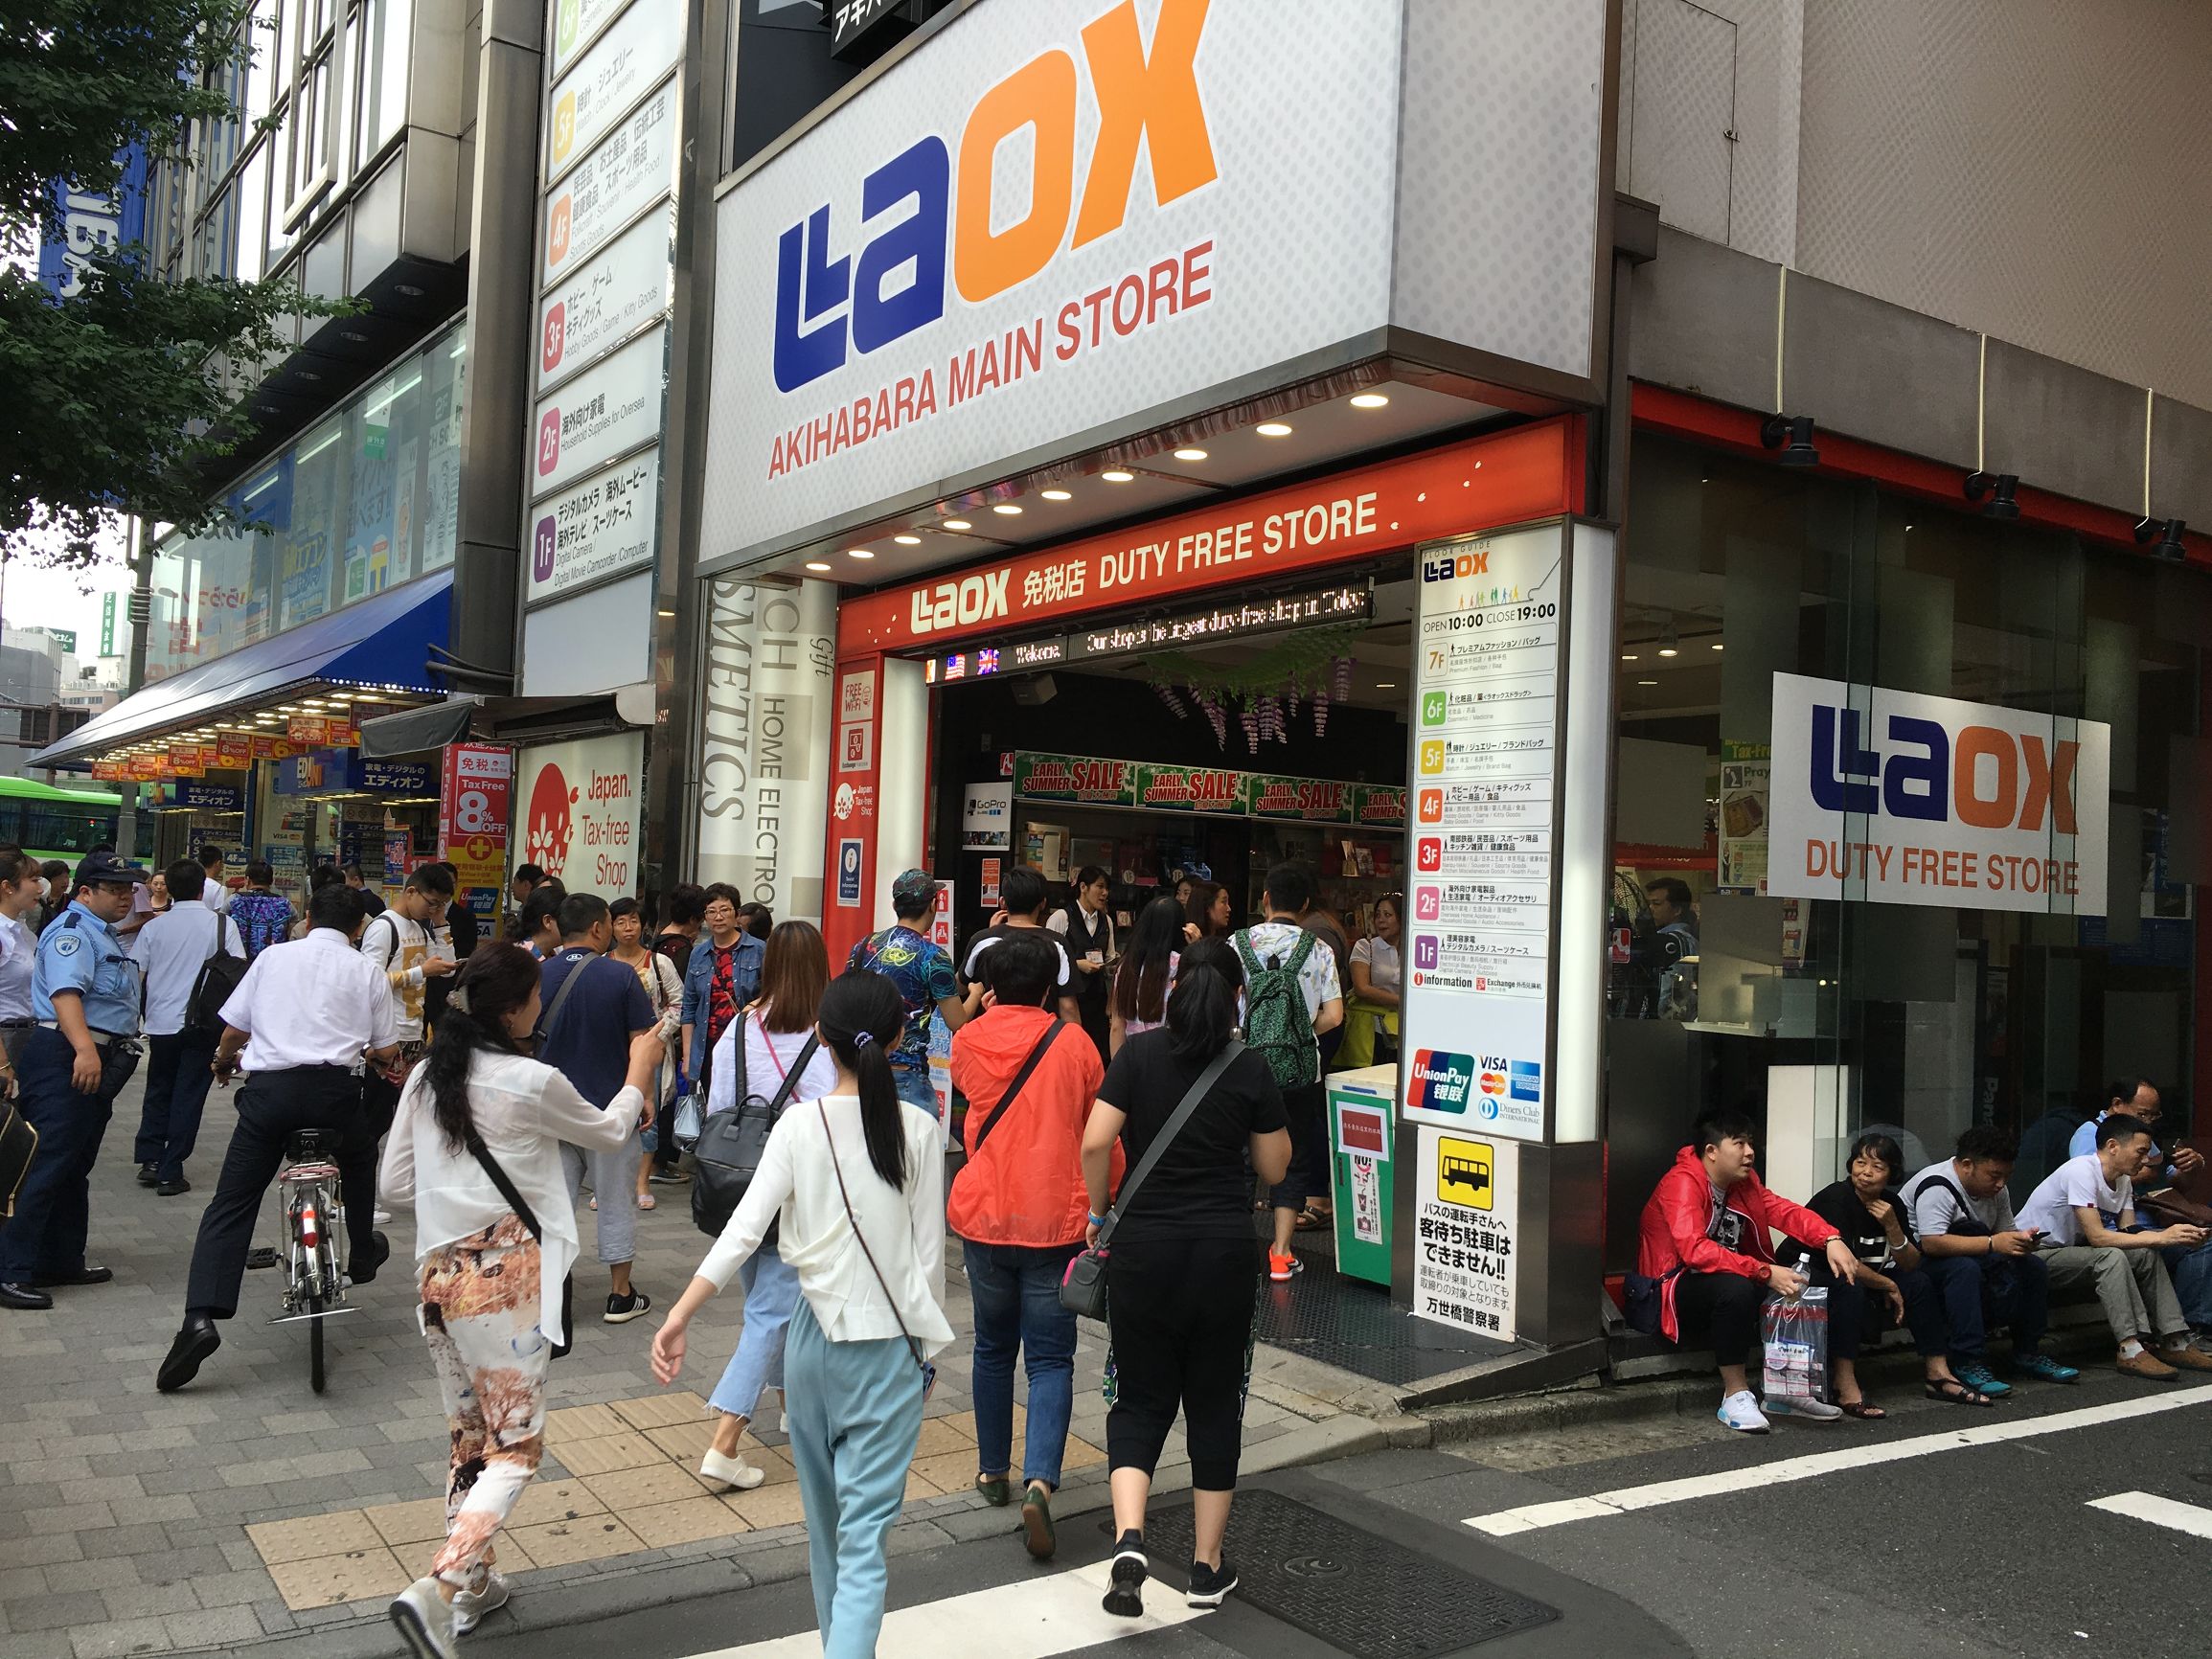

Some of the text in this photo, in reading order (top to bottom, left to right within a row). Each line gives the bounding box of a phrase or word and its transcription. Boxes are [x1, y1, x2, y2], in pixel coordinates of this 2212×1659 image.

[599, 48, 633, 92] ジュエリー
[558, 112, 571, 148] 5F
[605, 140, 648, 193] スポーツ用品
[552, 214, 567, 248] 4F
[567, 265, 612, 314] ホビー ゲーム
[603, 314, 619, 332] Game
[637, 285, 658, 309] Goods
[547, 321, 561, 357] 3F
[768, 240, 1213, 480] AKIHABARA MAIN STORE
[561, 393, 605, 436] 海外向け家電
[560, 428, 587, 452] Household
[588, 416, 611, 437] Supplies
[620, 397, 645, 420] Oversea
[543, 426, 557, 462] 2F
[558, 466, 648, 525] デジタルカメラ 海外ムービー
[557, 499, 632, 550] 海外テレビ スーツケース
[539, 534, 551, 567] 1F
[1022, 560, 1086, 609] 免税店
[1100, 540, 1171, 590] DUTY
[1176, 521, 1253, 572] FREE
[1263, 492, 1377, 555] STORE
[1461, 541, 1491, 553] GUIDE
[556, 550, 572, 567] Digital
[555, 553, 617, 587] Digital Movie Camcorder
[1424, 602, 1556, 633] OPEN 10:00 CLOSE 19:00
[1457, 636, 1540, 654] プレミアムファッション バッグ
[810, 637, 834, 677] Gift
[1429, 651, 1444, 670] 7F
[845, 682, 862, 697] FREE
[1455, 693, 1472, 703] 化粧品
[845, 698, 861, 712] Wi-Fi
[1426, 700, 1442, 718] 6F
[1470, 742, 1496, 752] ジュエリー
[1503, 739, 1544, 749] ブランドバッグ
[462, 757, 489, 771] 免税
[1425, 748, 1441, 767] 5F
[1034, 763, 1064, 777] EARLY
[1072, 762, 1124, 790] SALE
[364, 775, 425, 788] エディオン
[588, 769, 631, 807] Japan.
[857, 785, 873, 795] Japan
[1023, 778, 1070, 791] SUMMER
[1153, 774, 1183, 787] EARLY
[1189, 773, 1237, 800] SALE
[1496, 783, 1531, 791] キティグッズ
[1145, 787, 1187, 801] SUMMER
[1266, 784, 1292, 797] EARLY
[1298, 783, 1343, 809] SALE
[1368, 793, 1394, 806] EARLY
[1451, 792, 1499, 802] ベビー用品 食品
[188, 796, 234, 806] エディオン
[753, 697, 786, 912] HOME ELECTRO
[977, 800, 1006, 808] GoPro
[1257, 797, 1296, 810] SUMMER
[1424, 796, 1439, 815] 4F
[860, 807, 873, 817] Shop
[1360, 807, 1397, 819] SUMMER
[482, 824, 505, 832] OFF
[582, 814, 629, 846] Tax-free
[1500, 834, 1539, 843] スポーツ用品
[1423, 845, 1437, 864] 3F
[596, 853, 627, 894] Shop
[1806, 839, 2080, 896] DUTY FREE STORE
[1448, 885, 1494, 894] 海外向け家電製品
[1421, 893, 1436, 913] 2F
[1421, 943, 1434, 962] 1F
[1447, 943, 1529, 955] デジタルカメラ スーツケース
[1424, 973, 1516, 989] information Exchange
[1479, 1056, 1508, 1072] VISA
[1415, 1062, 1470, 1090] UnionPay
[1434, 1083, 1463, 1102] 银联
[1500, 1102, 1539, 1117] Diners Club
[1499, 1114, 1539, 1125] INTERNATIONAL
[1424, 1202, 1507, 1230] バスの運転手さんへ
[1420, 1217, 1511, 1255] 客待ち駐車は
[1420, 1264, 1509, 1297] 運転者が乗車していても
[1421, 1277, 1510, 1311] 取締りの対象となります。
[1426, 1297, 1500, 1331] 万世橋警察署
